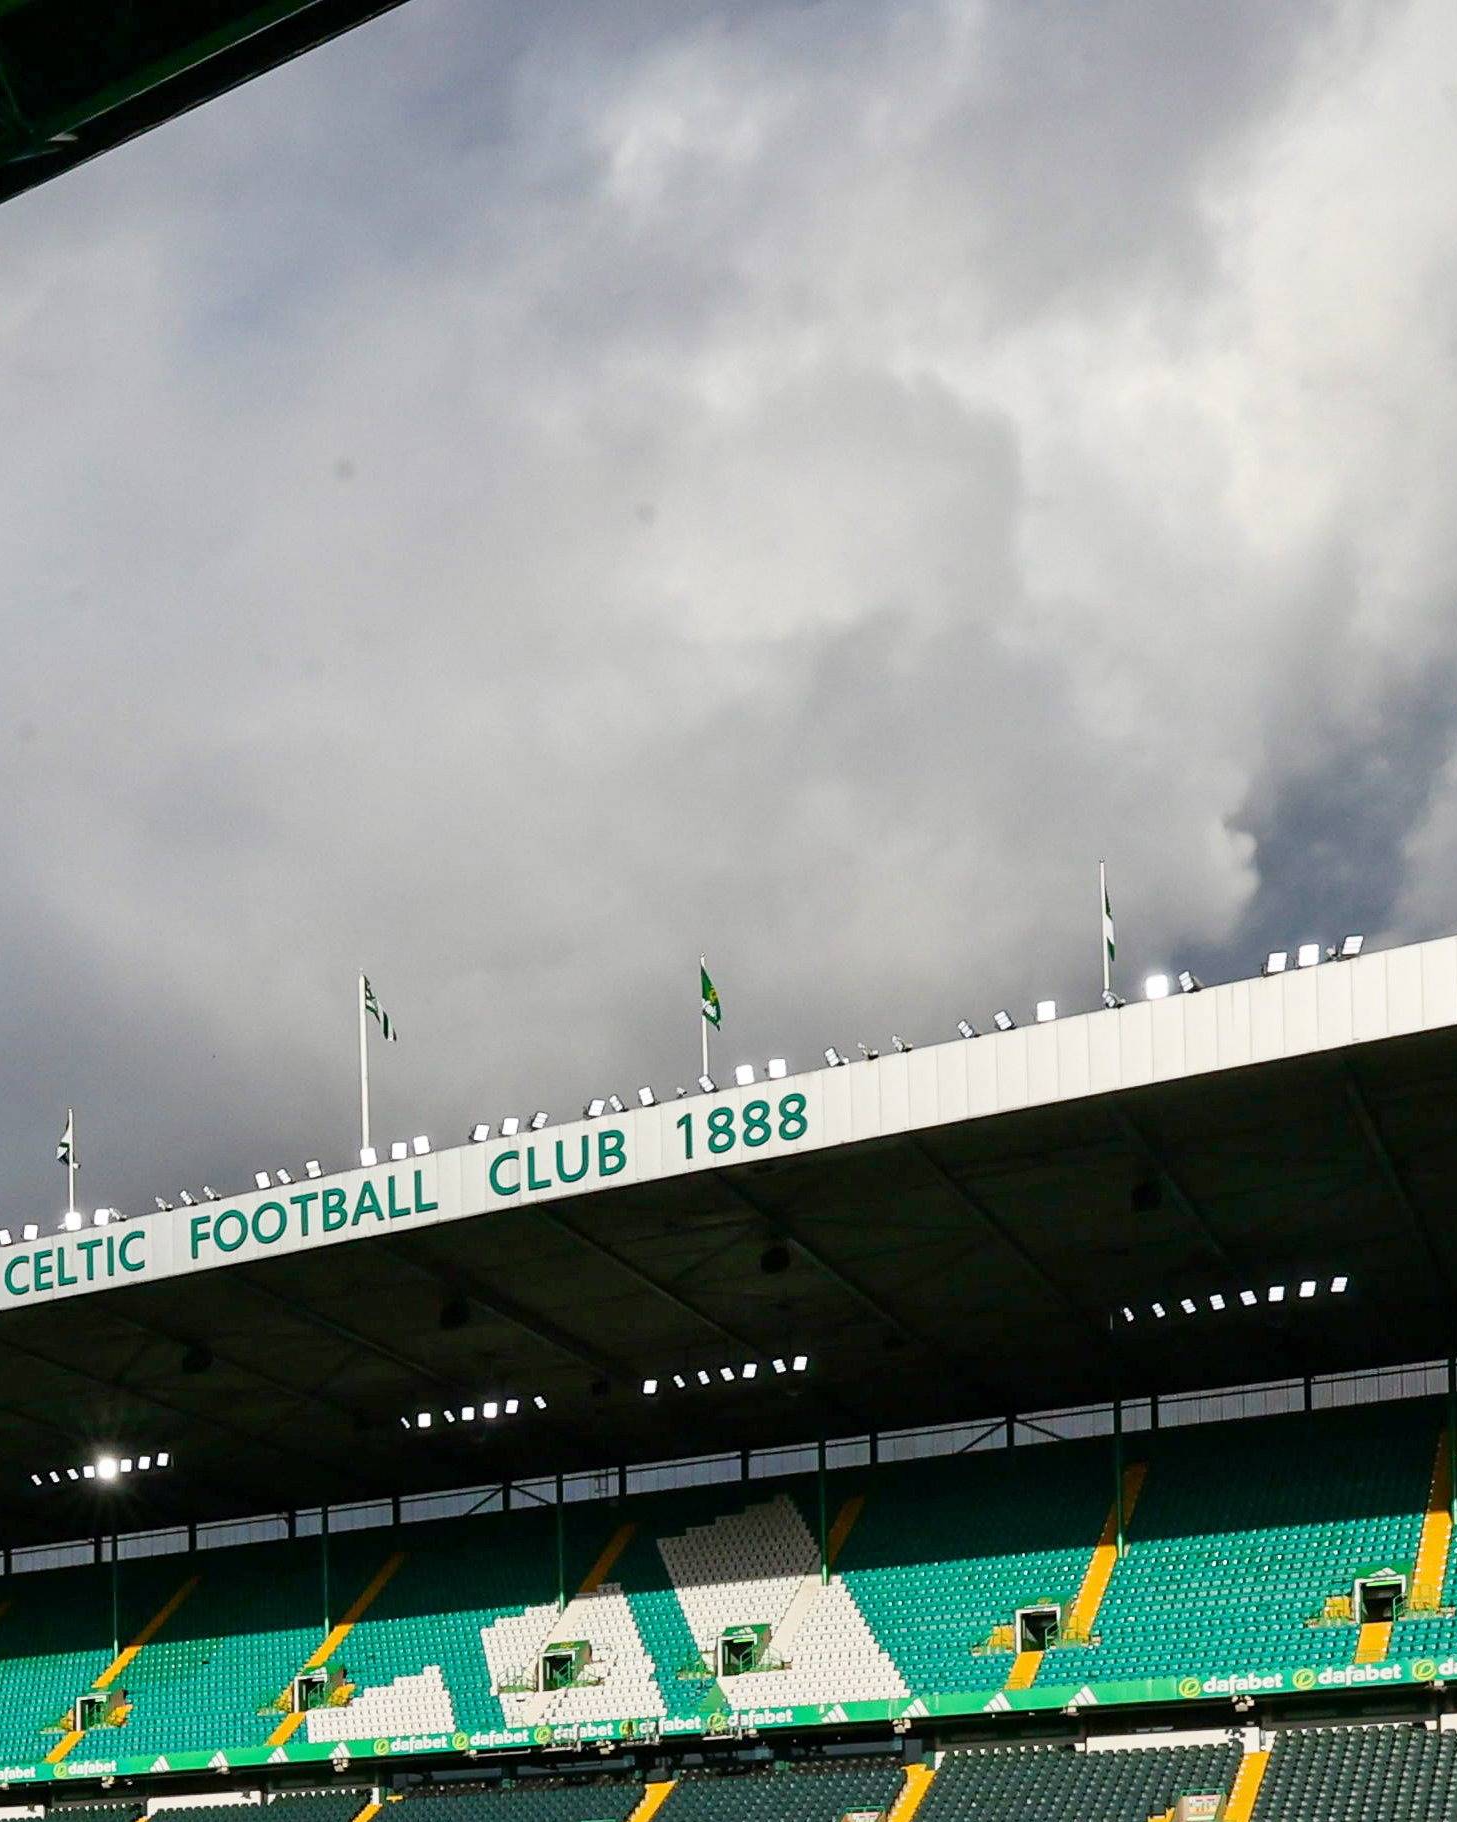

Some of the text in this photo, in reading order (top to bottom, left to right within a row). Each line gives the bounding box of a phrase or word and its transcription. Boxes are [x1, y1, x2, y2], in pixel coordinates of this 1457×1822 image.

[3, 1092, 810, 1297] CELTIC FOOTBALL CLUB 1888
[1317, 1663, 1402, 1685] dafabet
[1202, 1673, 1283, 1694] dafabet
[728, 1709, 793, 1727] dafabet
[390, 1735, 447, 1752] dafabet
[470, 1729, 529, 1747] dafabet
[67, 1760, 117, 1776] dafabet
